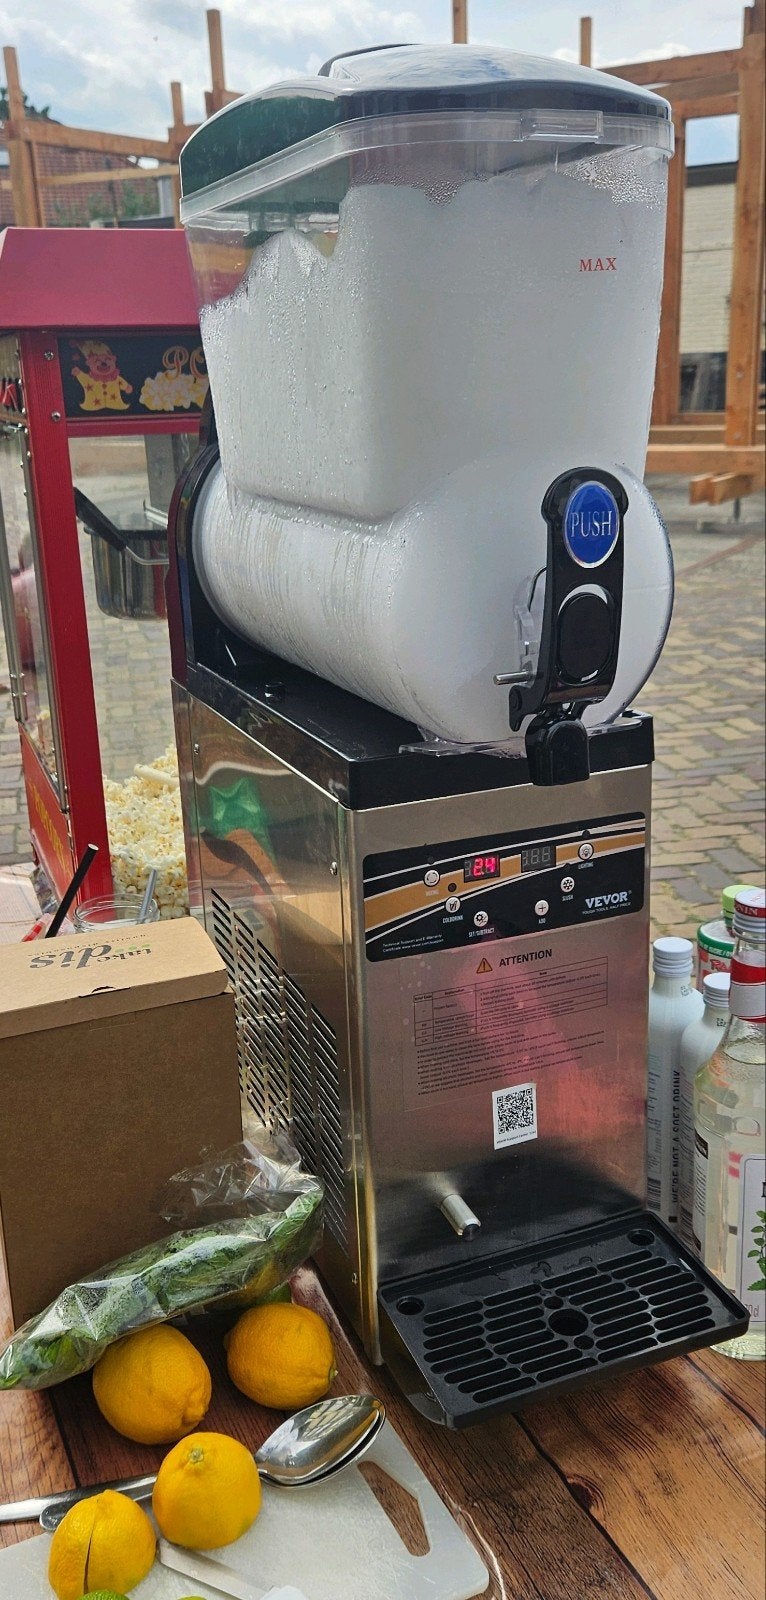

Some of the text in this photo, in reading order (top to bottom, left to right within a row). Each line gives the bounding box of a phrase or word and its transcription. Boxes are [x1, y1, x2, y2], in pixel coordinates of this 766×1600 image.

[578, 257, 617, 272] MAX
[570, 510, 613, 538] PUSH
[584, 891, 628, 909] VEVOR
[29, 944, 112, 969] dis
[96, 947, 153, 964] take
[499, 949, 553, 968] ATTENTION
